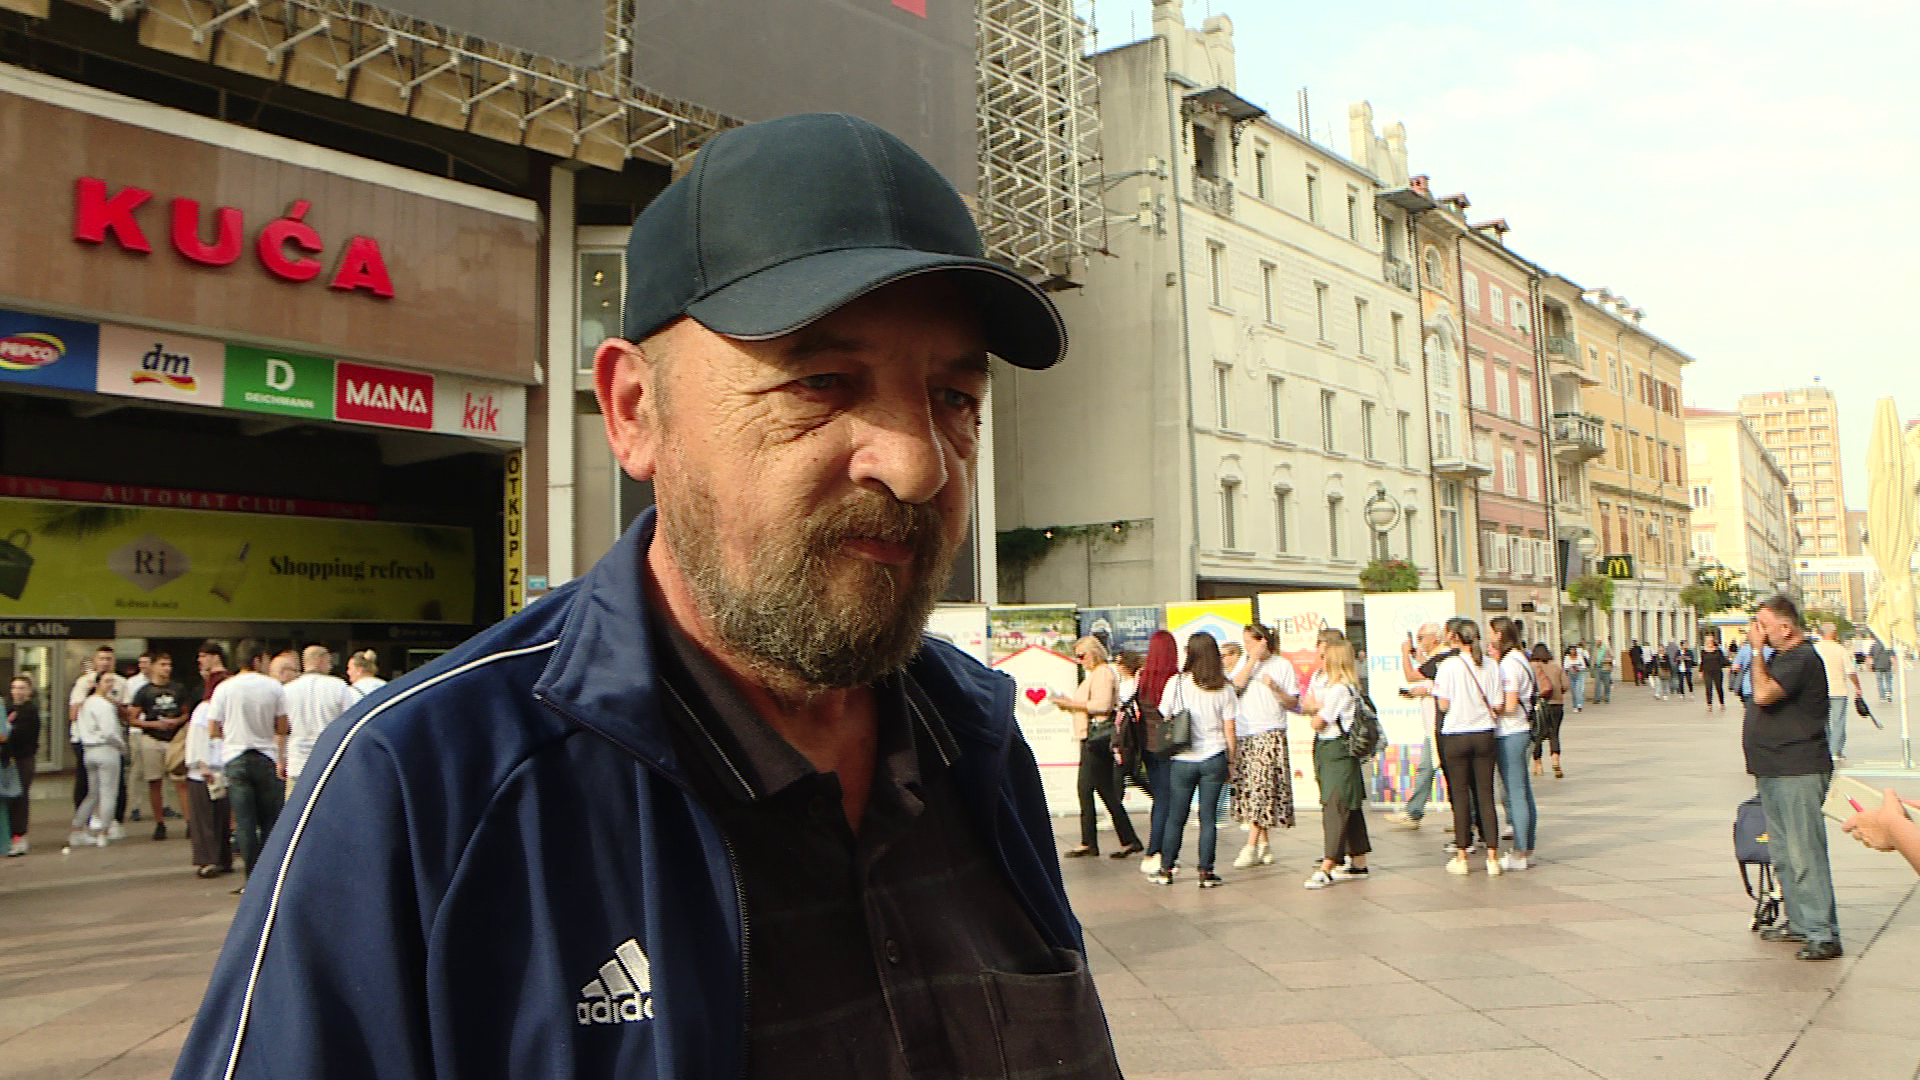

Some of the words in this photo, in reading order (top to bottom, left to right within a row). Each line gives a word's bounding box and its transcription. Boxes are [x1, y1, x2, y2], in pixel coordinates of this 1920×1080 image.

[73, 176, 395, 299] KUĆA
[142, 343, 190, 374] dm
[266, 358, 295, 391] D
[244, 391, 315, 409] DEICHMANN
[346, 378, 427, 414] MANA
[463, 391, 499, 432] kik
[102, 485, 227, 509] AUTOMAT
[237, 495, 296, 514] CLUB
[507, 456, 520, 557] OTKUP
[134, 550, 167, 575] Ri
[269, 555, 366, 580] Shopping
[369, 559, 436, 580] refresh
[508, 568, 520, 614] ZL
[1274, 611, 1331, 635] TERRA
